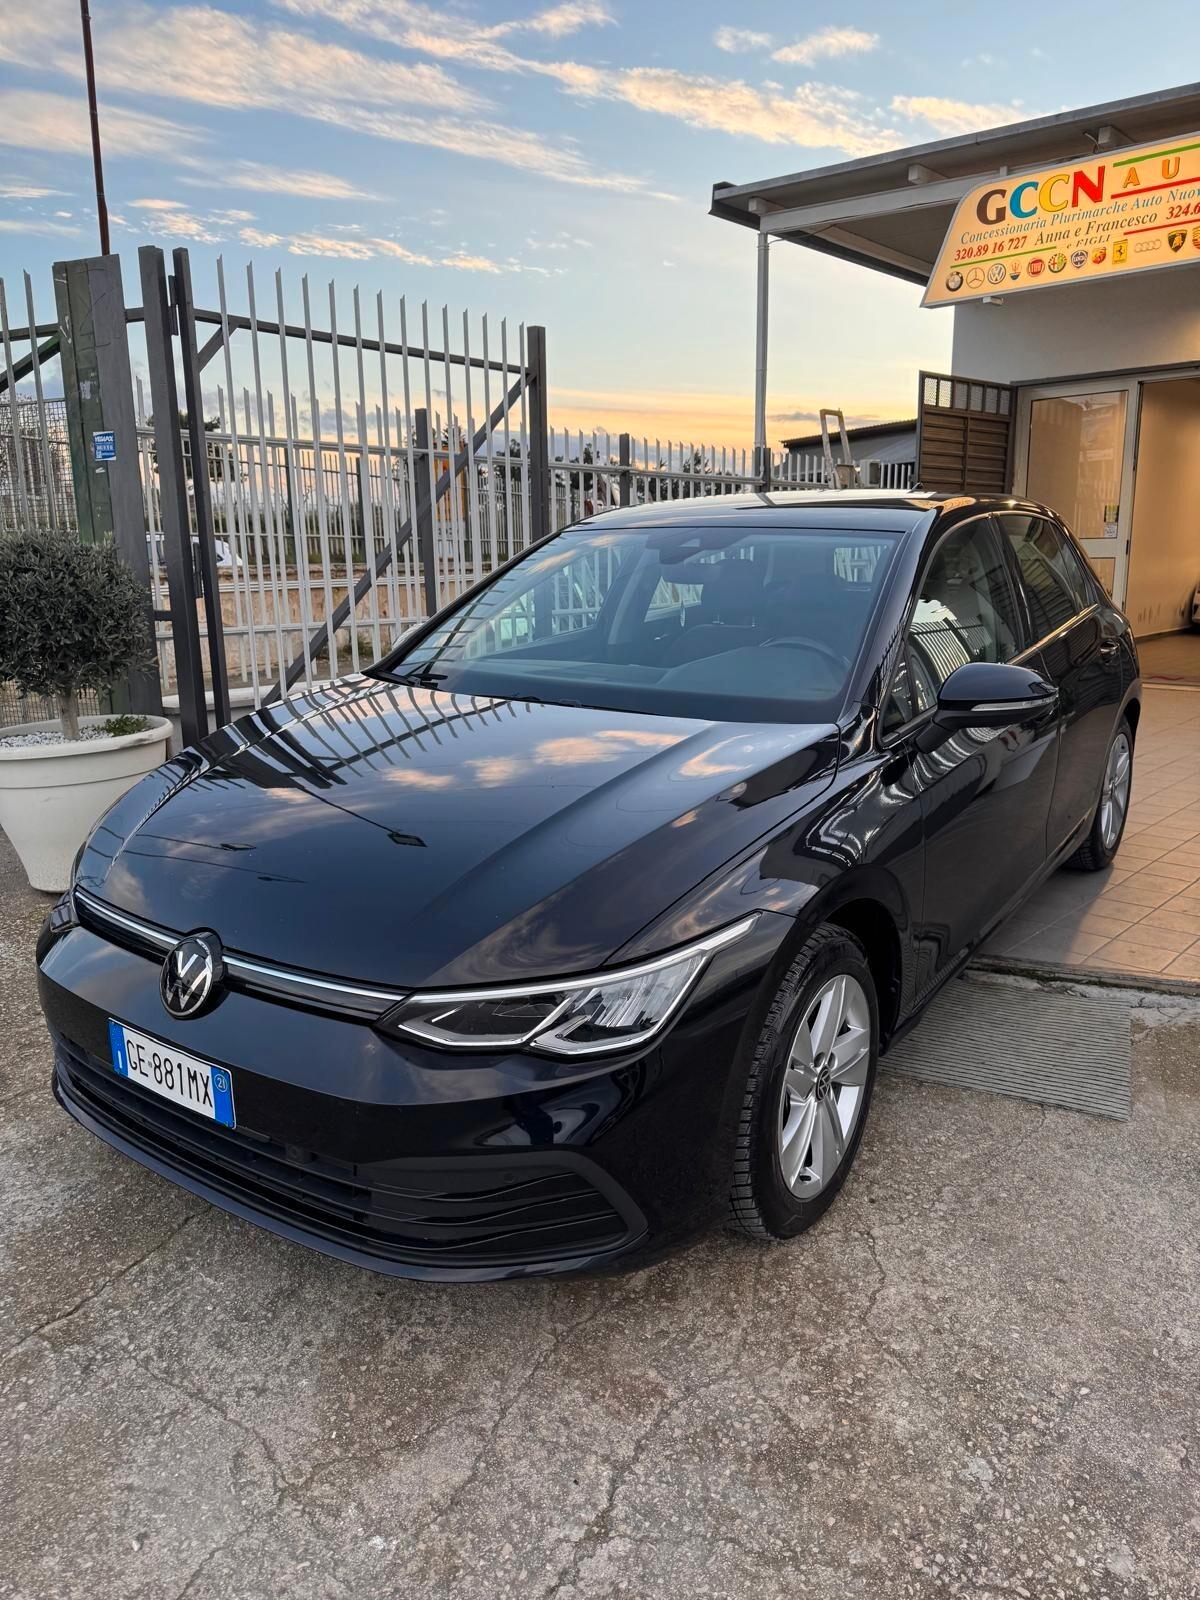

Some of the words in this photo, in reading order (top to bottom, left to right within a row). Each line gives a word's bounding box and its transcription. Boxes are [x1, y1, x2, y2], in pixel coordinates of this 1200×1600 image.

[961, 217, 1046, 245] Concessionaria
[1050, 201, 1128, 227] Plurimarche
[1131, 195, 1162, 210] Auto
[977, 166, 1105, 226] GCCN
[954, 244, 988, 261] 320.89
[992, 240, 1004, 254] 16
[1007, 236, 1027, 250] 727
[1035, 229, 1070, 246] Anna
[1075, 228, 1081, 236] e
[1085, 213, 1158, 235] Francesco
